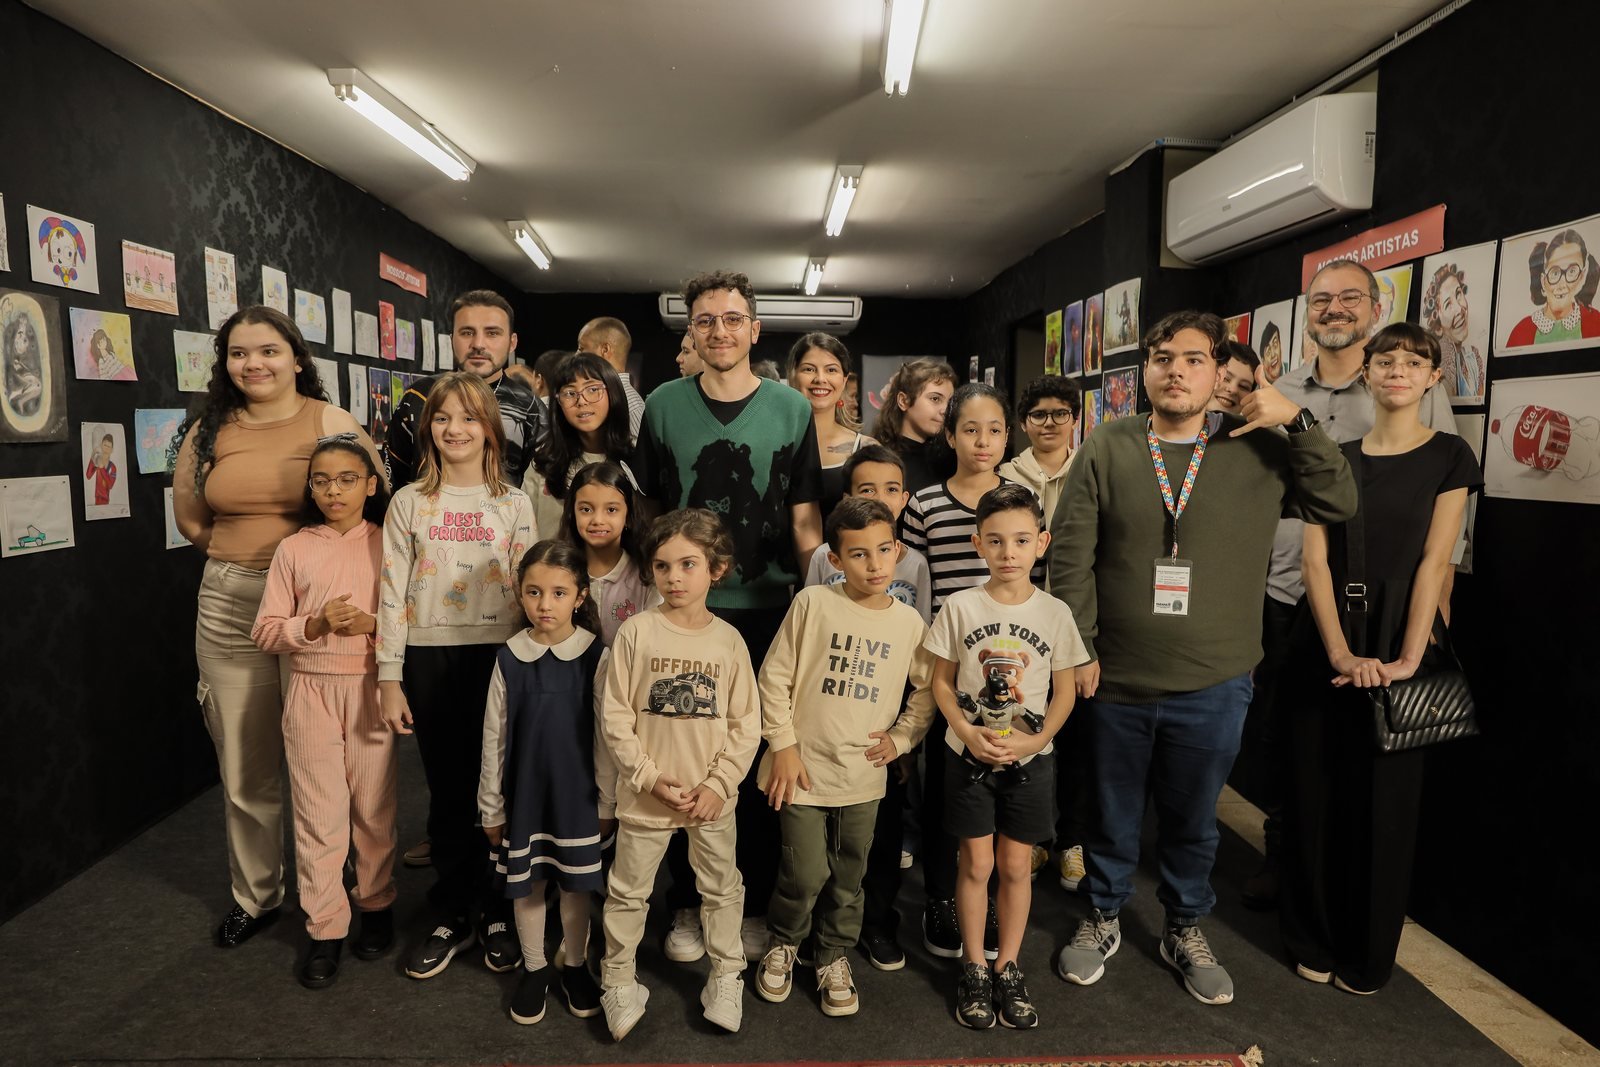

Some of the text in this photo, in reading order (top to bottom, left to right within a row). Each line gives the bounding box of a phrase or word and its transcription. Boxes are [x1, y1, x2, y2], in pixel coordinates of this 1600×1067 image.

[1360, 229, 1420, 263] ARTISTAS
[444, 511, 484, 527] BEST
[429, 526, 495, 542] FRIENDS
[456, 561, 473, 572] happy
[481, 613, 497, 622] happy
[830, 632, 891, 660] LIVE
[963, 622, 1051, 658] NEW YORK
[650, 657, 721, 679] OFFROAD
[829, 654, 876, 679] THE
[821, 677, 880, 703] RIDE
[431, 926, 453, 940] NIKE
[488, 922, 507, 936] NIKE
